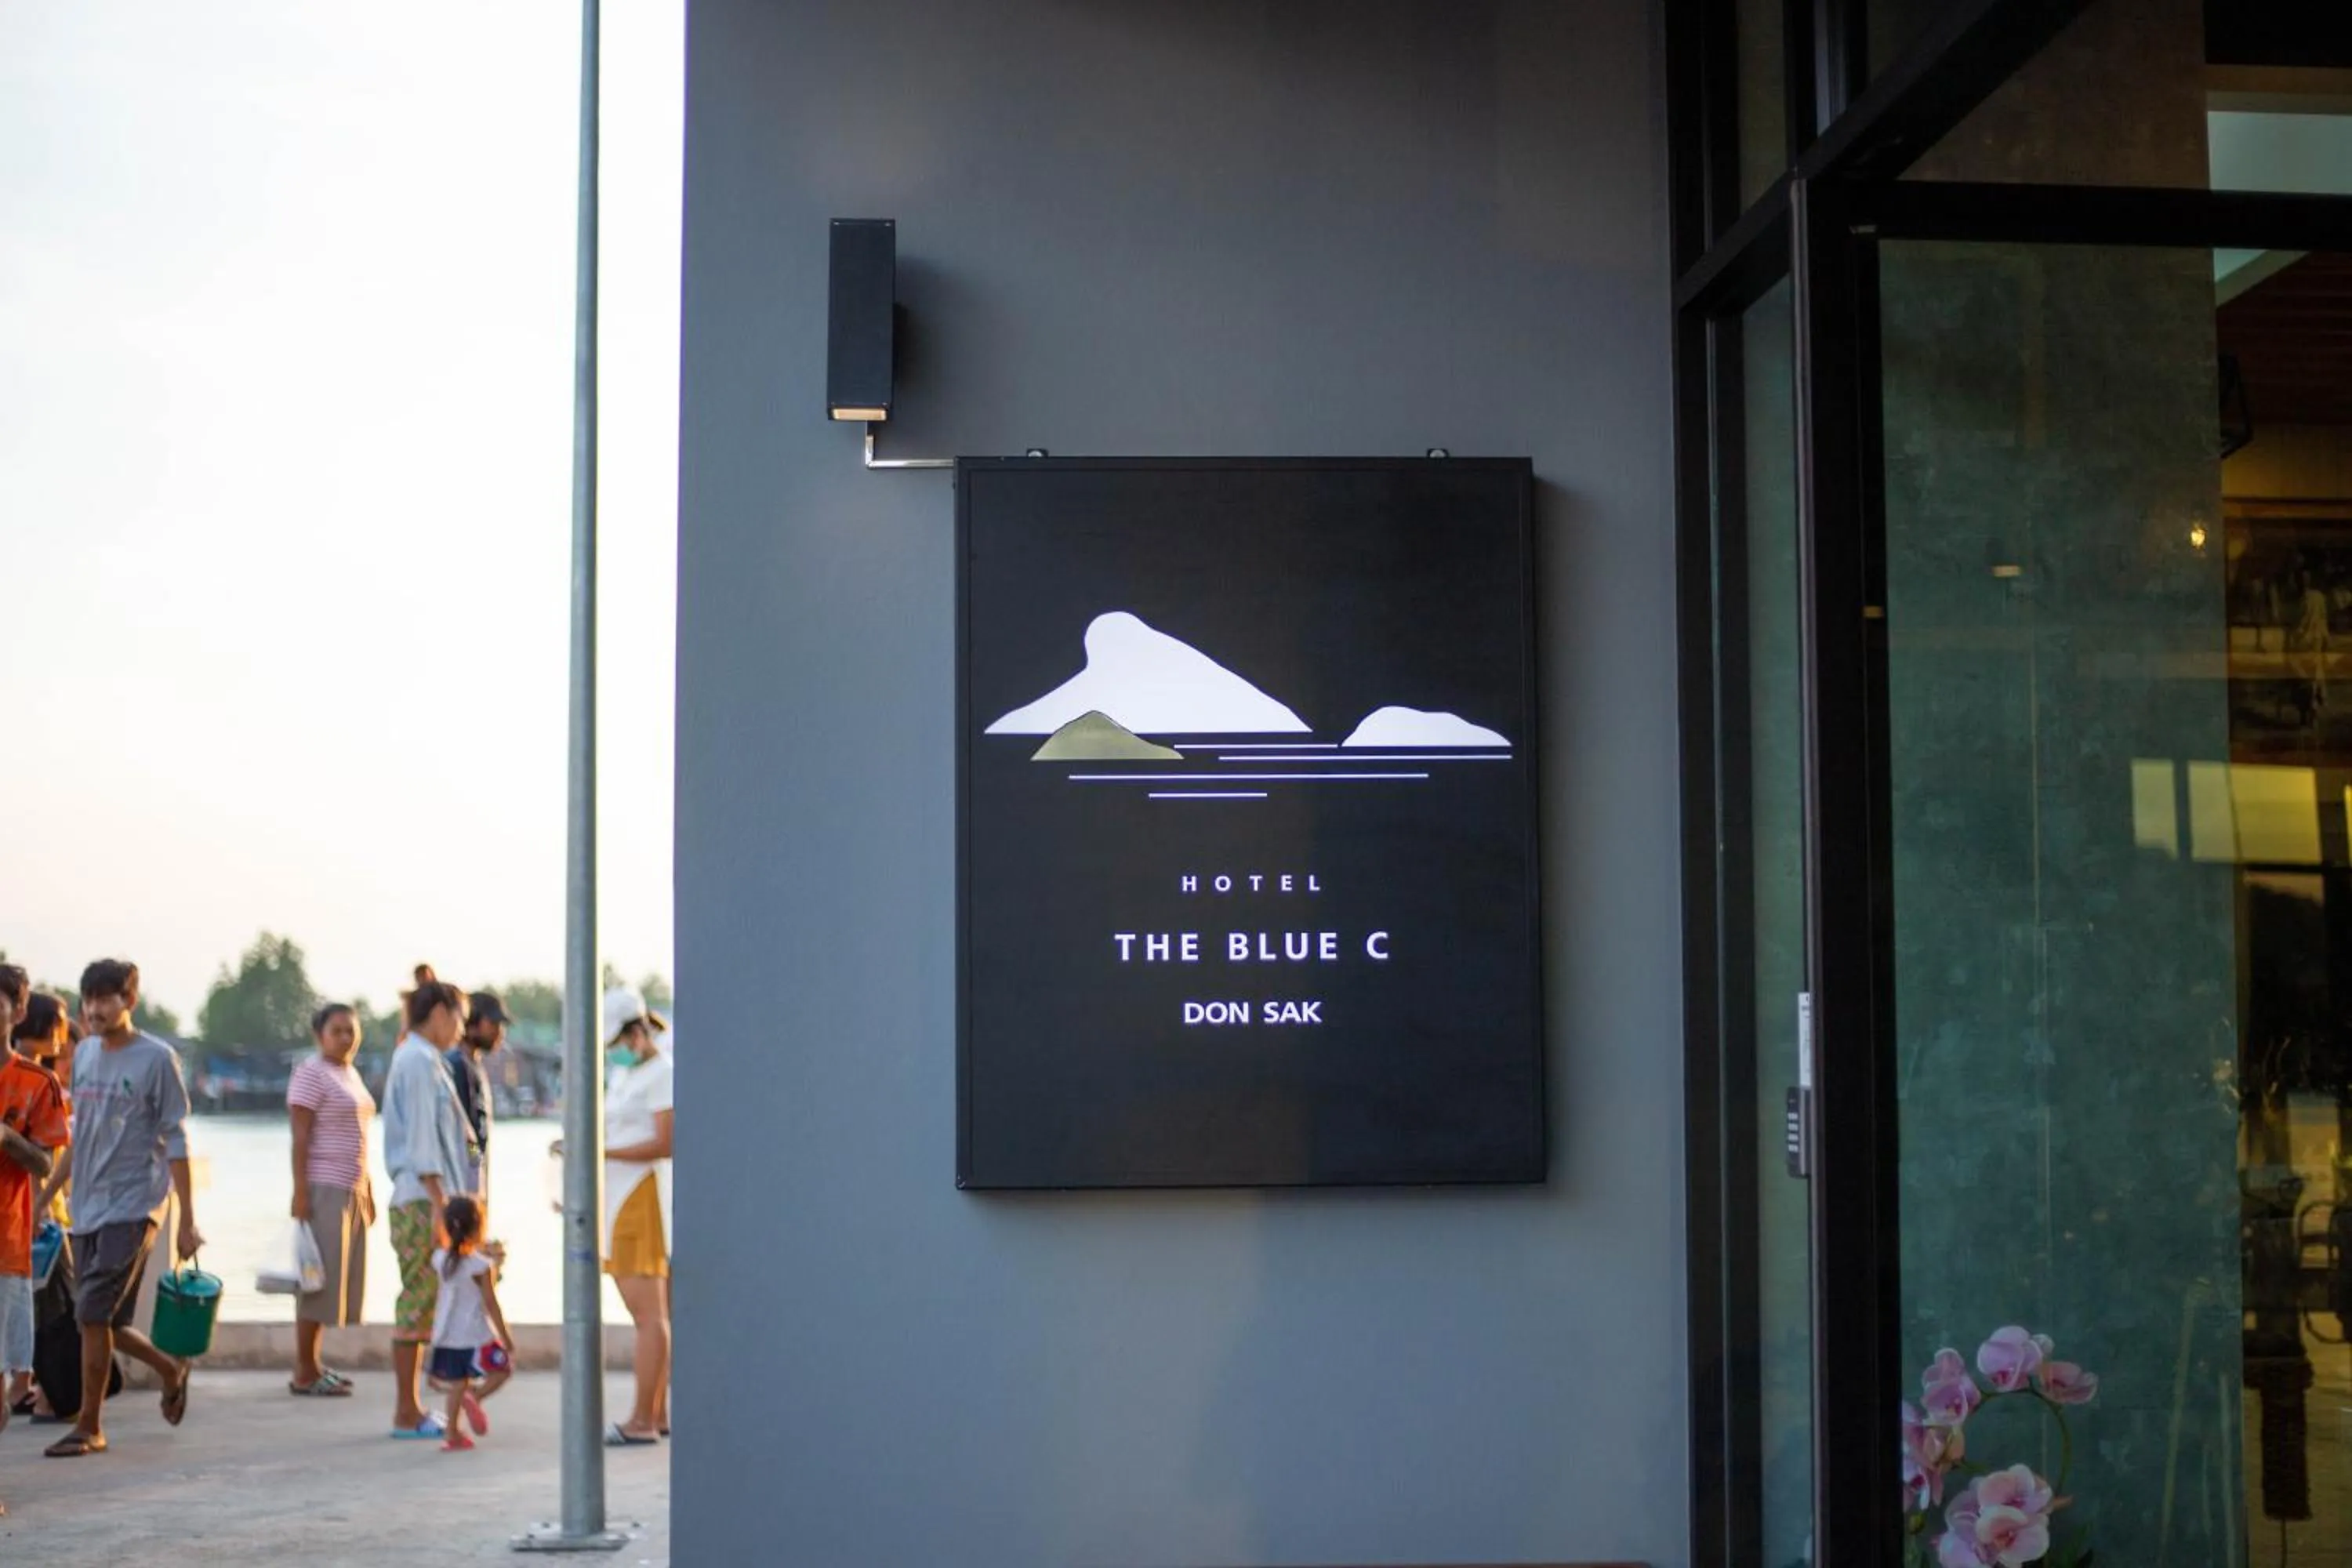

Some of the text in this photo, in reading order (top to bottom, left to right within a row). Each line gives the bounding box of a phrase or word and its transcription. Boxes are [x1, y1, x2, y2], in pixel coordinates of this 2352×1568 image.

[1181, 875, 1321, 892] HOTEL
[1113, 931, 1388, 961] THE BLUE C
[1184, 1001, 1322, 1024] DON SAK
